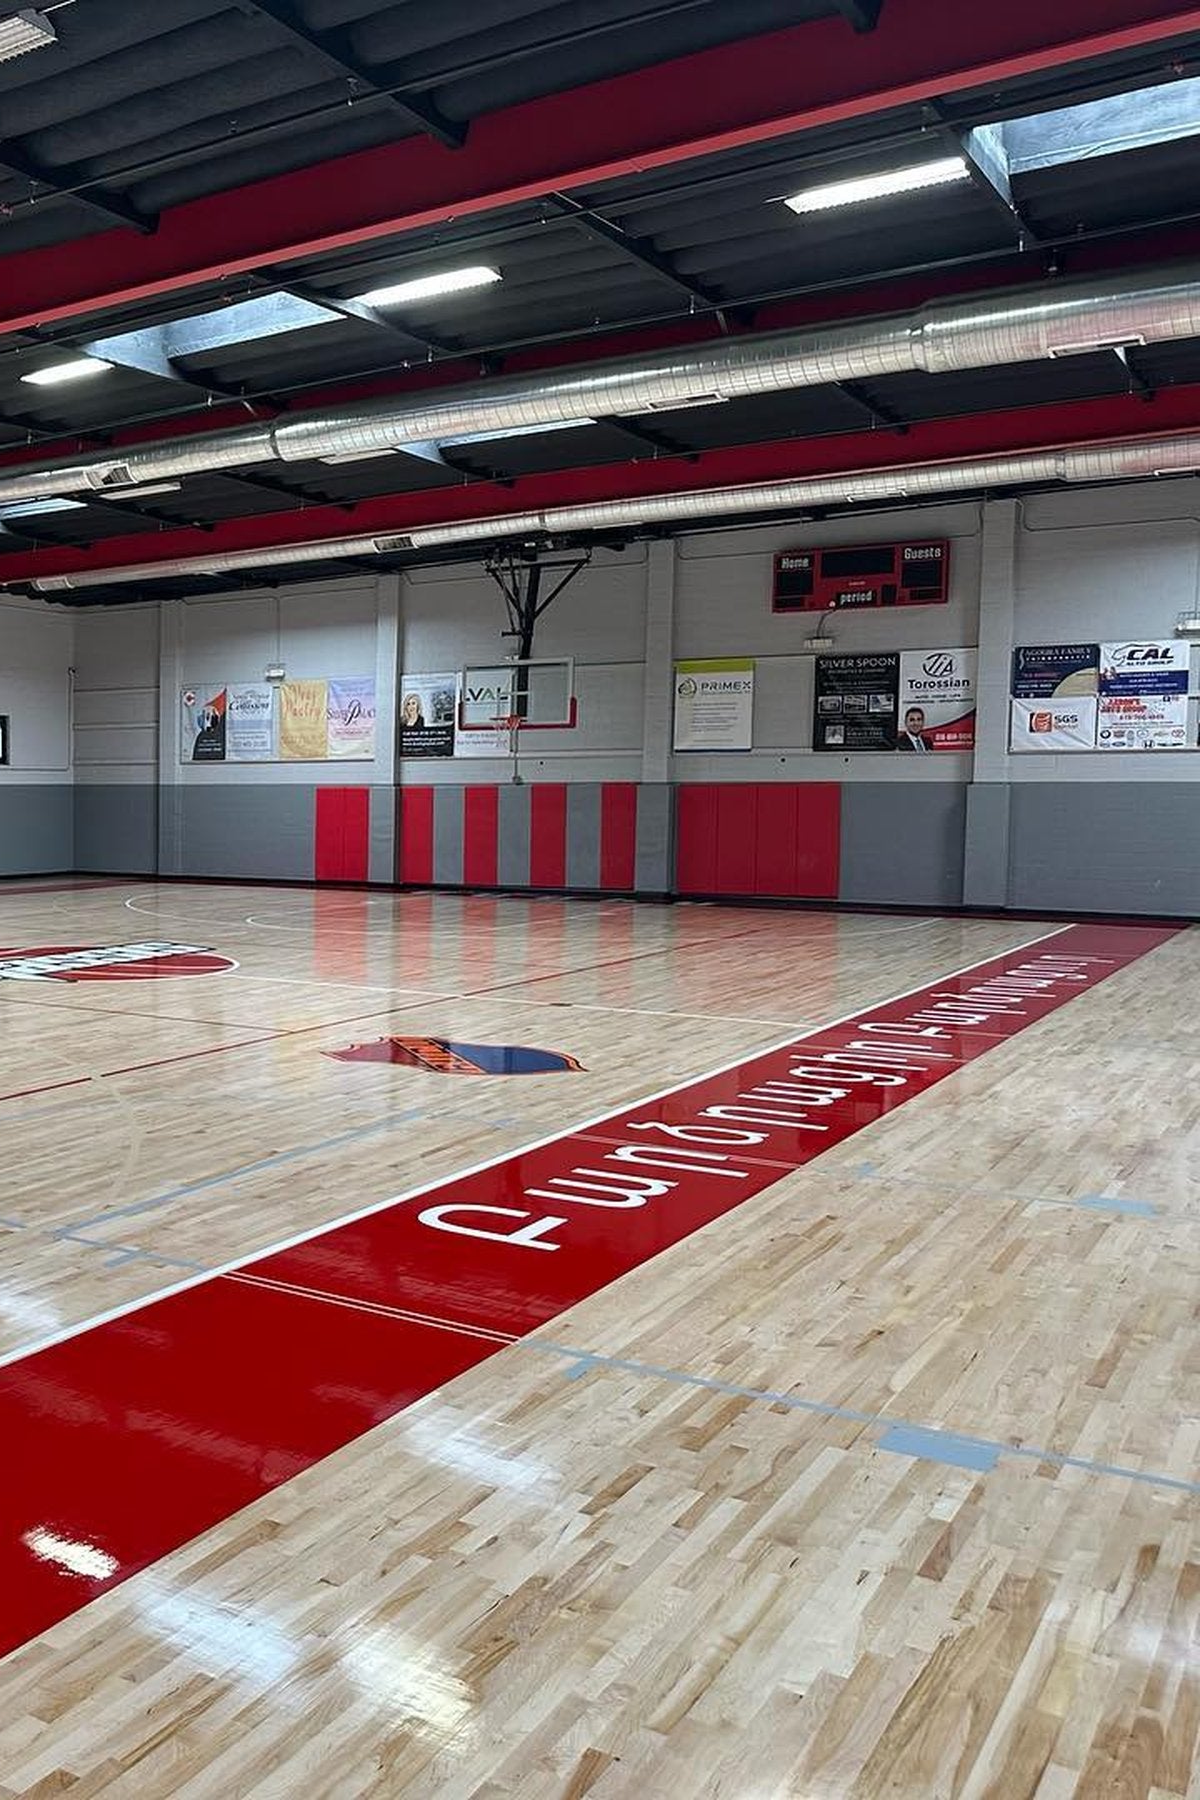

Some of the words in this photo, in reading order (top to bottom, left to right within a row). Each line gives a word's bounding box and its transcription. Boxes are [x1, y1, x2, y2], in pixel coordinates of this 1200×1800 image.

[904, 547, 942, 560] Guests
[781, 557, 810, 569] Home
[840, 591, 873, 605] period
[1127, 647, 1175, 661] CAL
[819, 659, 855, 670] SILVER
[856, 657, 897, 669] SPOON
[700, 680, 752, 691] PRIMEX
[907, 678, 971, 690] Torossian
[1054, 714, 1079, 723] SGS
